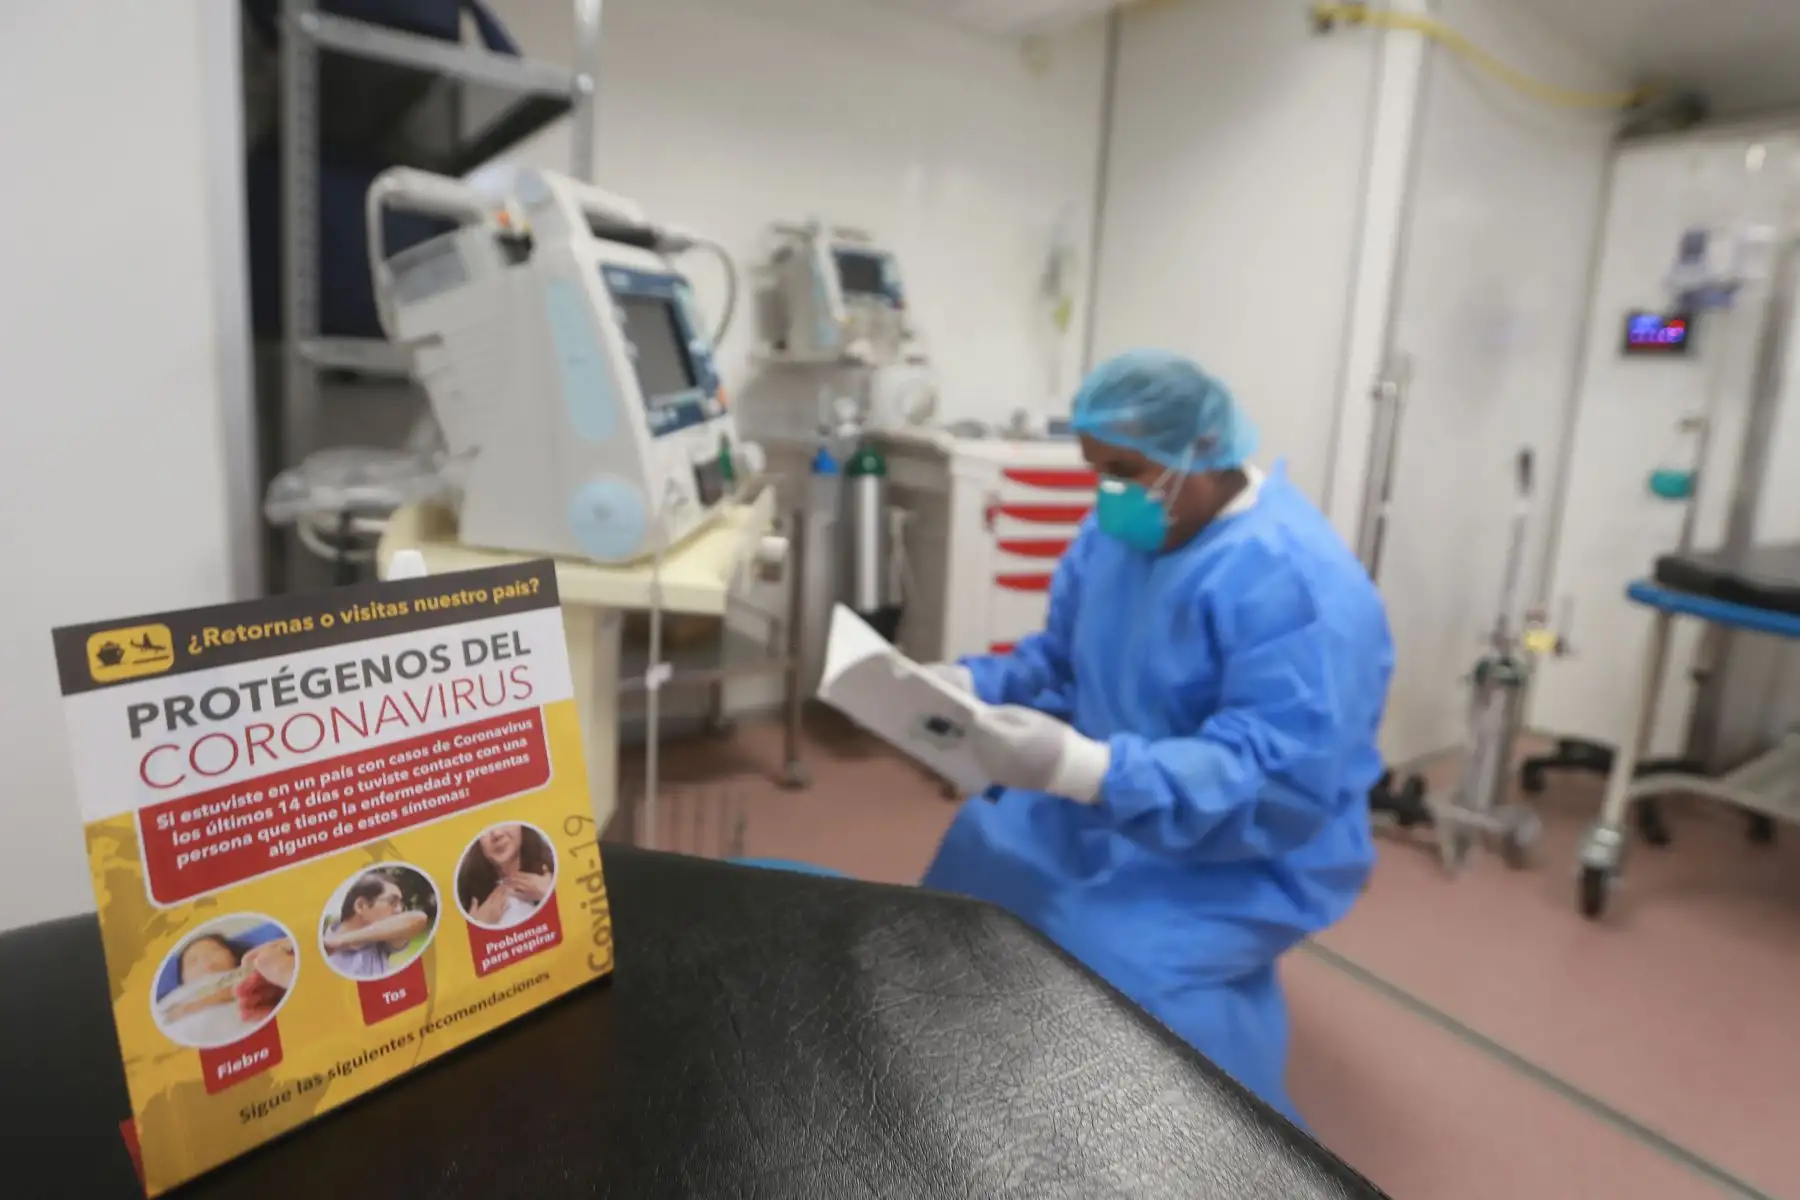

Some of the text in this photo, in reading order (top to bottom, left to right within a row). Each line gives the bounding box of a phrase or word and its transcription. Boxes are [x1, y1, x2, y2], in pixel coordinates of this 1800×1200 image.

[188, 577, 540, 655] ¿Retornas o visitas nuestro país?
[127, 630, 532, 739] PROTÉGENOS DEL
[140, 665, 533, 789] CORONAVIRUS
[156, 718, 532, 830] Si estuviste en un país con casos de Coronavirus
[172, 738, 528, 846] los últimos 14 días o tuviste contacto con una
[176, 752, 530, 869] persona que tiene la enfermedad y presentas
[269, 788, 470, 857] alguno de estos síntomas:
[486, 923, 548, 954] Problemas
[563, 815, 613, 973] Covid-19
[382, 988, 407, 1004] Tos
[481, 931, 556, 971] para respirar
[216, 1047, 270, 1080] Fiebre
[239, 972, 550, 1124] Sigue las siguientes recomendaciones
